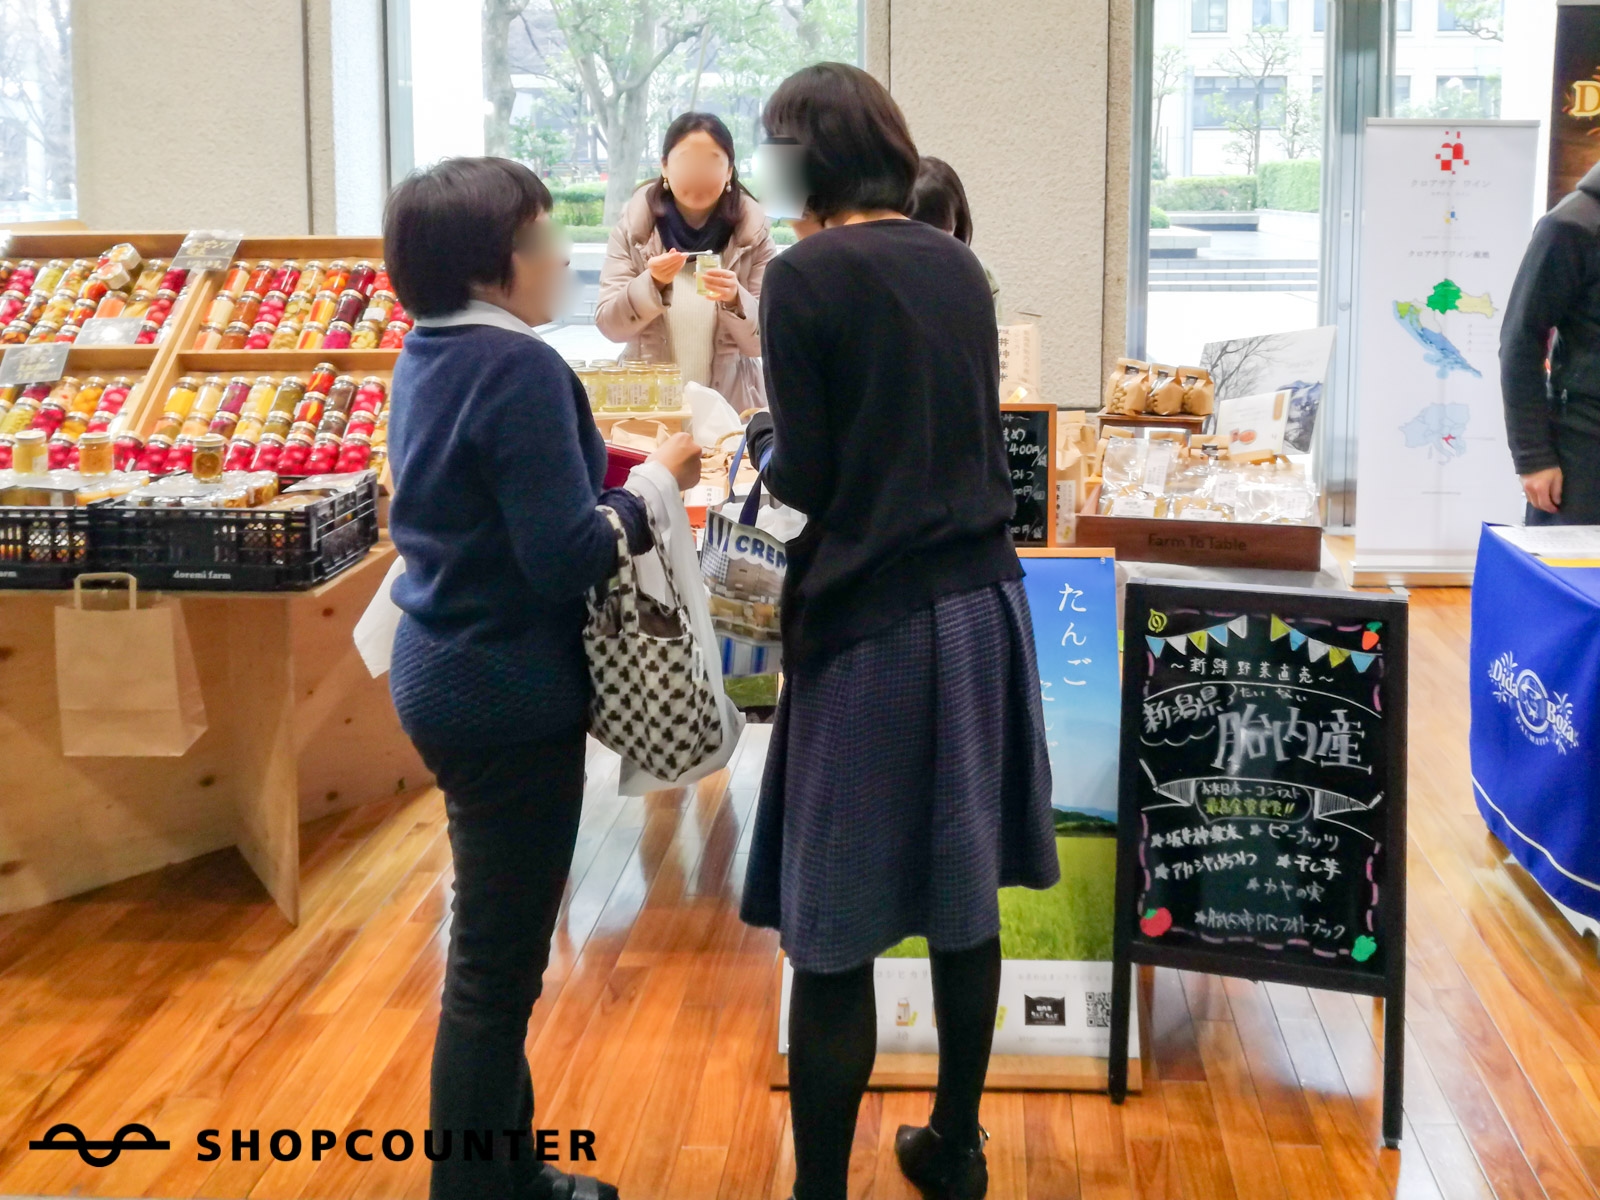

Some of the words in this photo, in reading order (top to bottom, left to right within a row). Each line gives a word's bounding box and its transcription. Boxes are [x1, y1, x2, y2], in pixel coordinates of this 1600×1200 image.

[1148, 532, 1186, 548] Farm
[1188, 534, 1205, 549] To
[1209, 536, 1247, 551] Table
[1143, 685, 1223, 734] 新潟県
[1211, 703, 1373, 775] 胎内産
[1268, 823, 1339, 852] ピーナッツ
[1294, 854, 1342, 880] 干し芋
